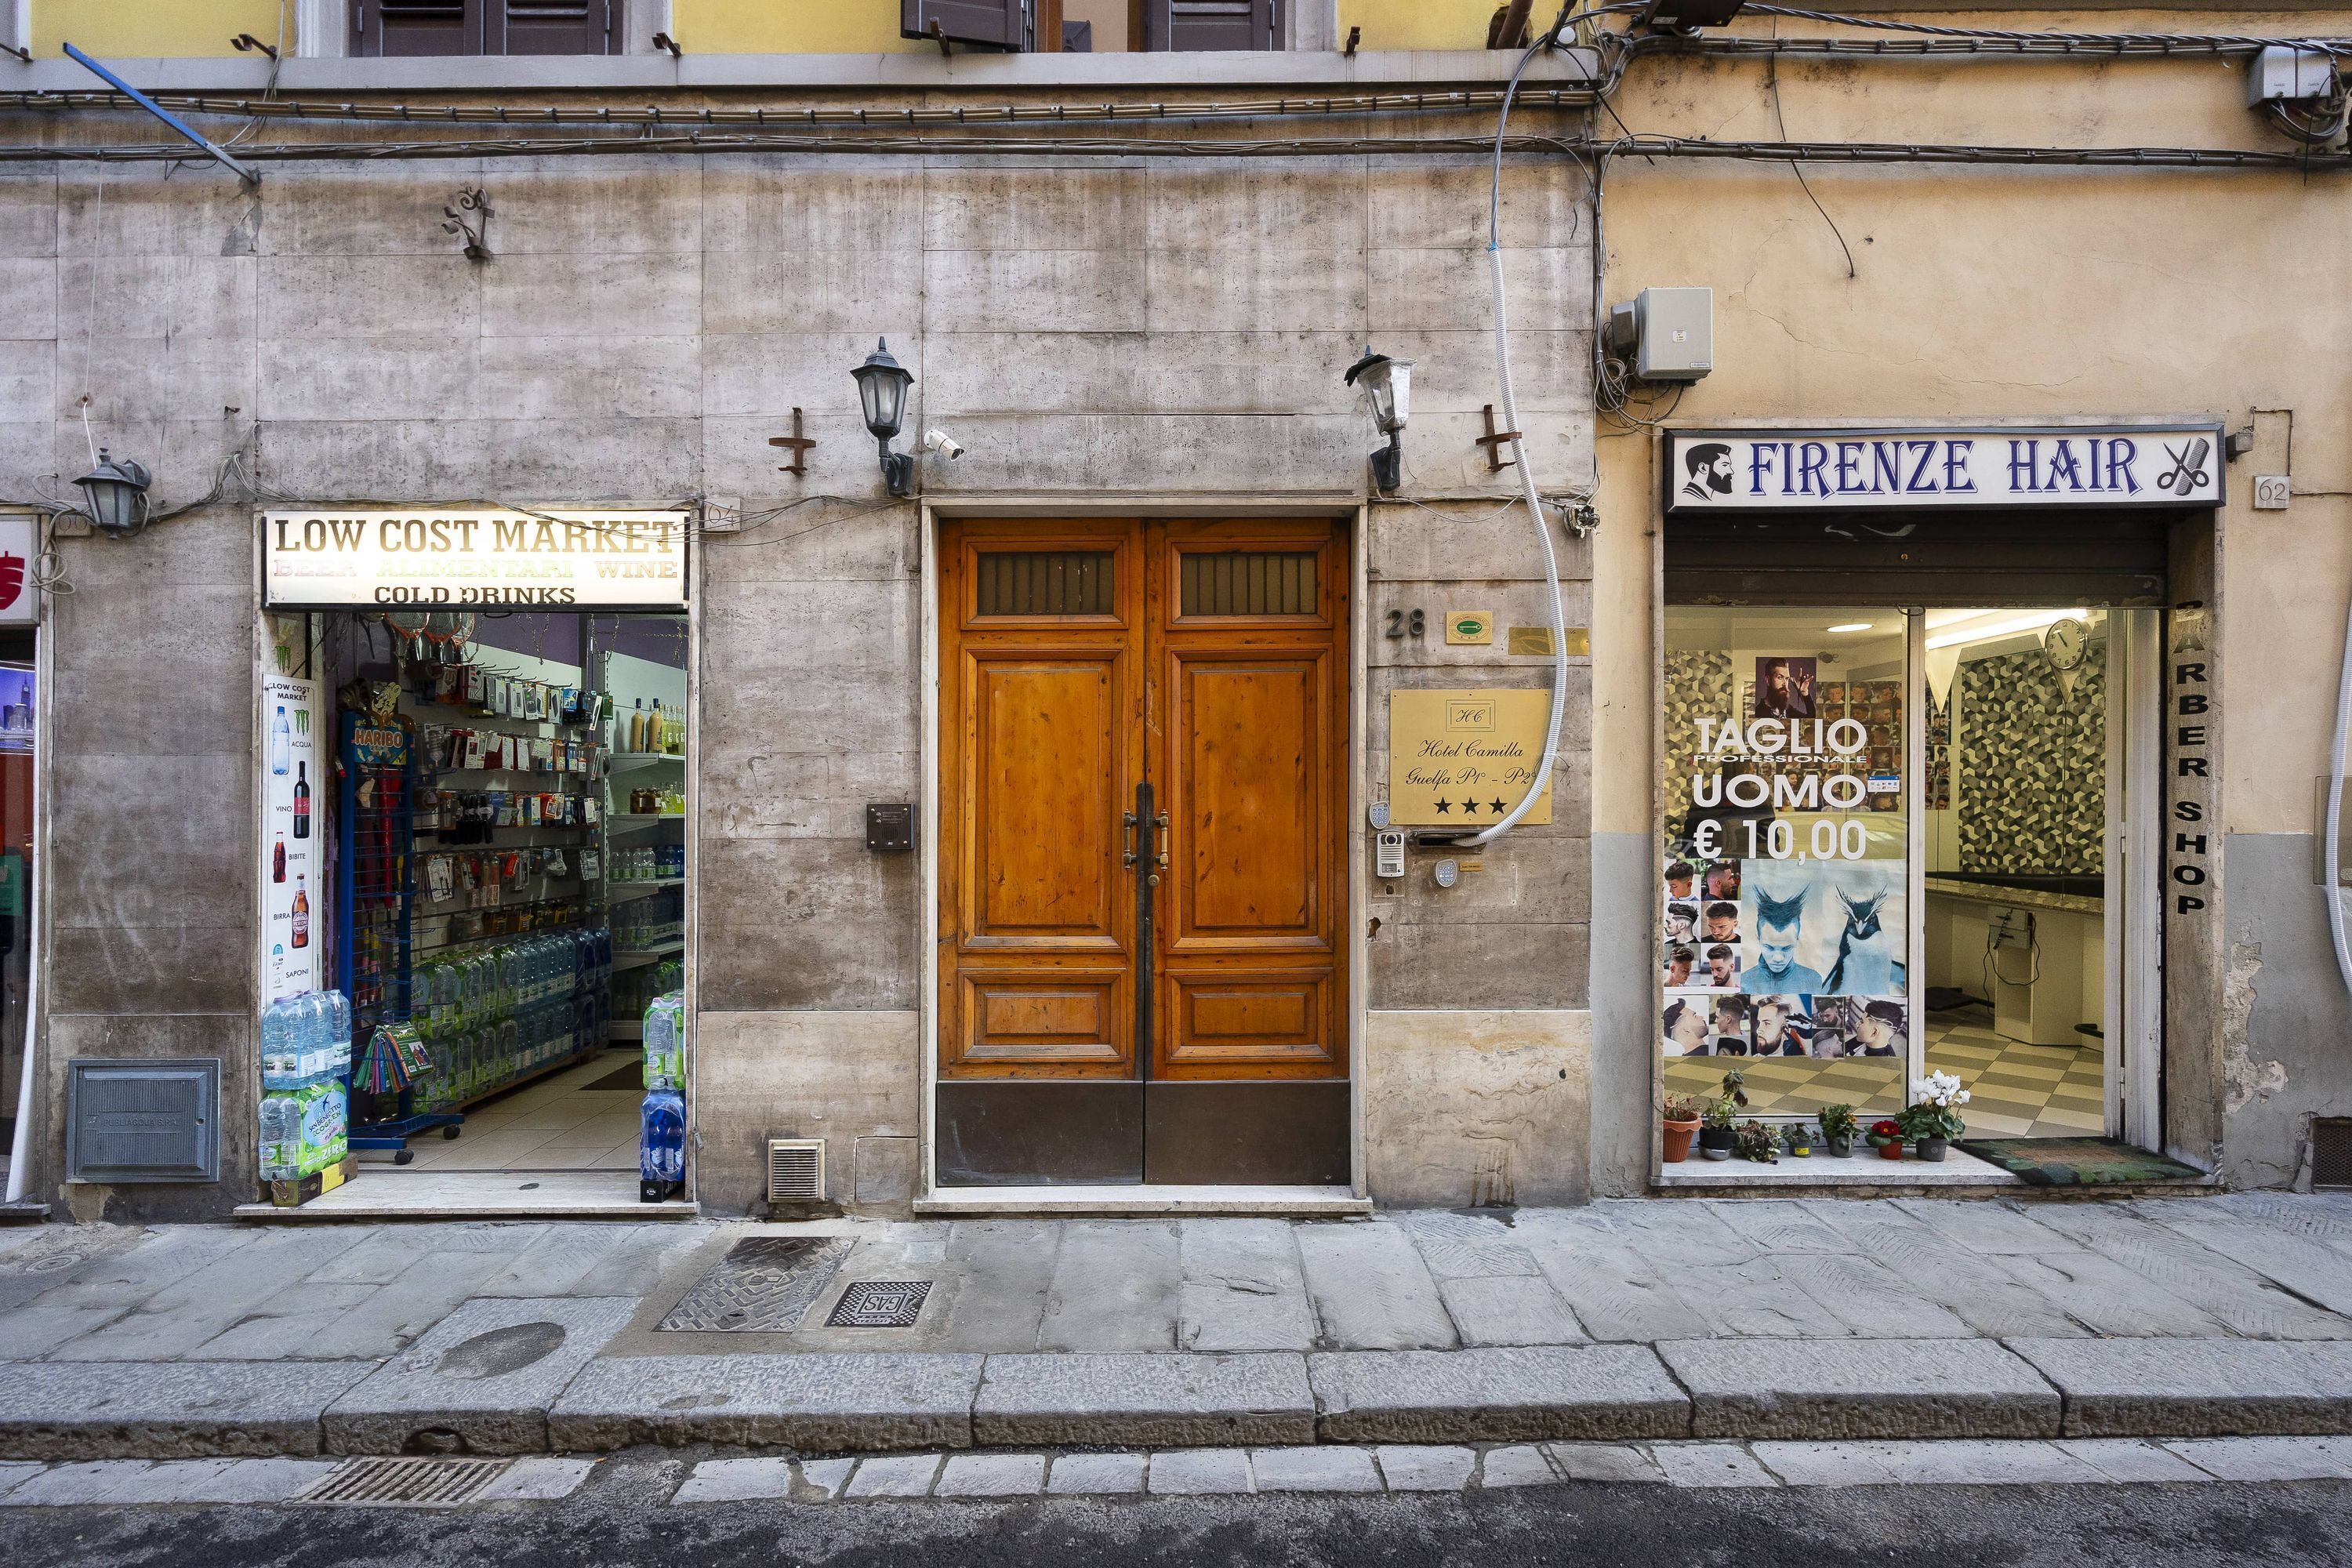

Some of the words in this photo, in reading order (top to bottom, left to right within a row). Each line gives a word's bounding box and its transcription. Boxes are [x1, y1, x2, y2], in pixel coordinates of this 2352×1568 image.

[1749, 440, 1979, 500] FIRENZE
[2007, 437, 2143, 497] HAIR
[2258, 478, 2287, 502] 62
[274, 519, 367, 552] LOW
[379, 518, 479, 554] COST
[493, 520, 678, 554] MARKET
[274, 559, 358, 577] BEER
[376, 559, 573, 579] ALIMENTARI
[593, 560, 678, 579] WINE
[374, 586, 450, 604] COLD
[460, 586, 576, 605] DRINKS
[1385, 608, 1425, 637] 28
[272, 682, 291, 691] LOW
[292, 684, 310, 693] COST
[277, 691, 307, 702] MARKET
[354, 728, 404, 749] HARIBO
[1693, 717, 1867, 755] TAGLIO
[1417, 739, 1464, 758] Hotel
[1464, 739, 1524, 758] Camilla
[1693, 754, 1868, 764] PROFESSIONALE
[1405, 767, 1452, 792] Guelfa
[1693, 773, 1867, 809] UOMO
[1693, 818, 1722, 860] €
[1743, 819, 1867, 867] 10,00
[288, 852, 307, 861] BIBITE
[2172, 800, 2207, 916] SHOP
[285, 968, 310, 978] SAPONI
[321, 1139, 347, 1161] ZERO
[864, 1295, 902, 1311] GAS
